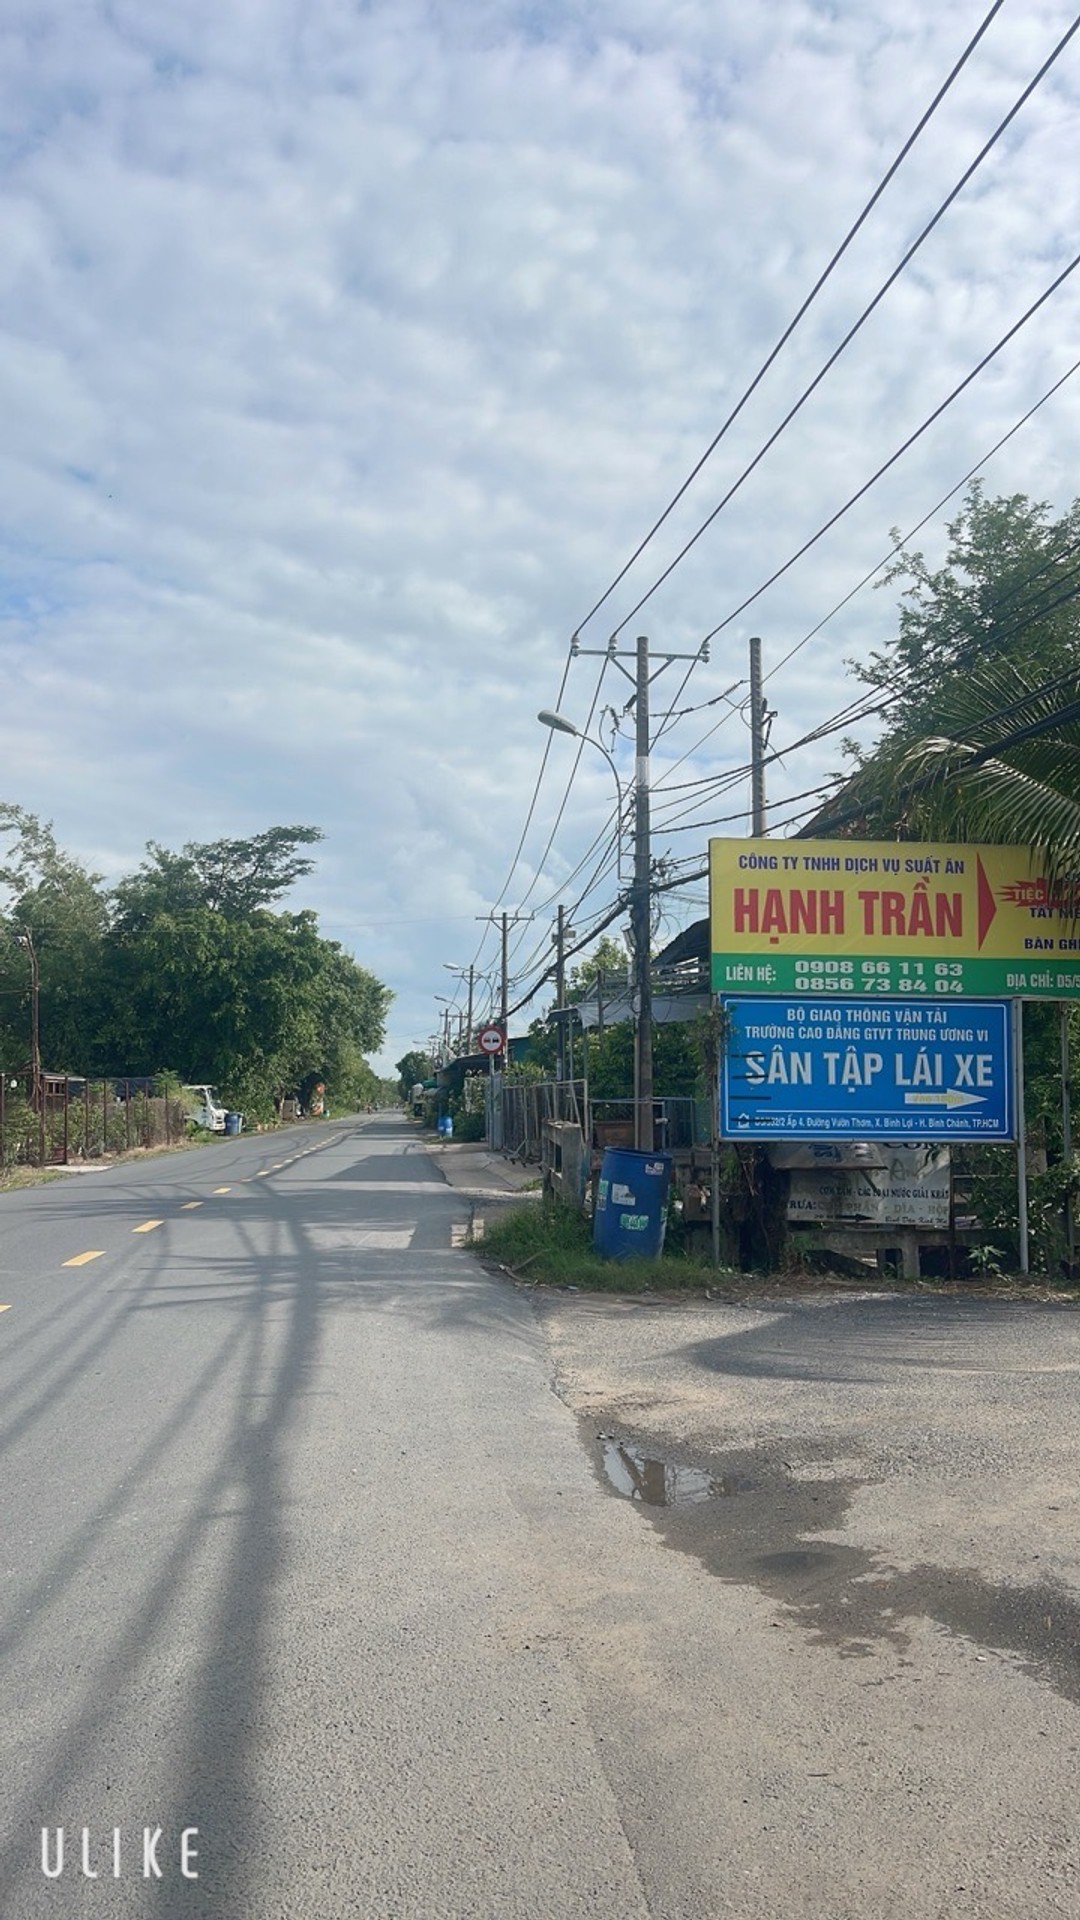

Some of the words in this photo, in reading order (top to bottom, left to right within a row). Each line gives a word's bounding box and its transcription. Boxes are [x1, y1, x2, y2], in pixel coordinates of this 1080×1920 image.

[739, 852, 778, 870] CÔNG
[783, 856, 799, 870] TY
[803, 856, 840, 871] TNHH
[845, 857, 878, 874] DỊCH
[884, 858, 901, 875] VỤ
[905, 855, 941, 874] SUẤT
[1013, 886, 1044, 903] TIỆC
[734, 887, 845, 944] HẠNH
[858, 876, 963, 937] TRẦN
[1025, 936, 1054, 950] BÀN
[726, 963, 753, 982] LIÊN
[757, 963, 776, 984] HỆ:
[795, 960, 854, 974] 0908
[861, 961, 890, 975] 66
[899, 962, 924, 975] 11
[934, 962, 963, 976] 63
[795, 977, 854, 991] 0856
[861, 978, 891, 991] 73
[898, 979, 928, 992] 84
[934, 979, 964, 993] 04
[1006, 973, 1027, 990] ĐỊA
[1030, 969, 1054, 988] CHỈ:
[787, 1006, 806, 1024] BỘ
[810, 1009, 842, 1022] GIAO
[845, 1007, 891, 1023] THÔNG
[895, 1008, 922, 1026] VẬN
[926, 1007, 947, 1024] TẢI
[745, 1023, 795, 1039] TRƯỜNG
[798, 1027, 823, 1040] CAO
[864, 1028, 893, 1041] GTVT
[896, 1028, 936, 1041] TRUNG
[940, 1028, 973, 1042] ƯƠNG
[977, 1029, 988, 1042] VI
[745, 1044, 812, 1085] SÂN
[823, 1045, 883, 1093] TẬP
[895, 1046, 942, 1086] LÁI
[954, 1053, 993, 1086] XE
